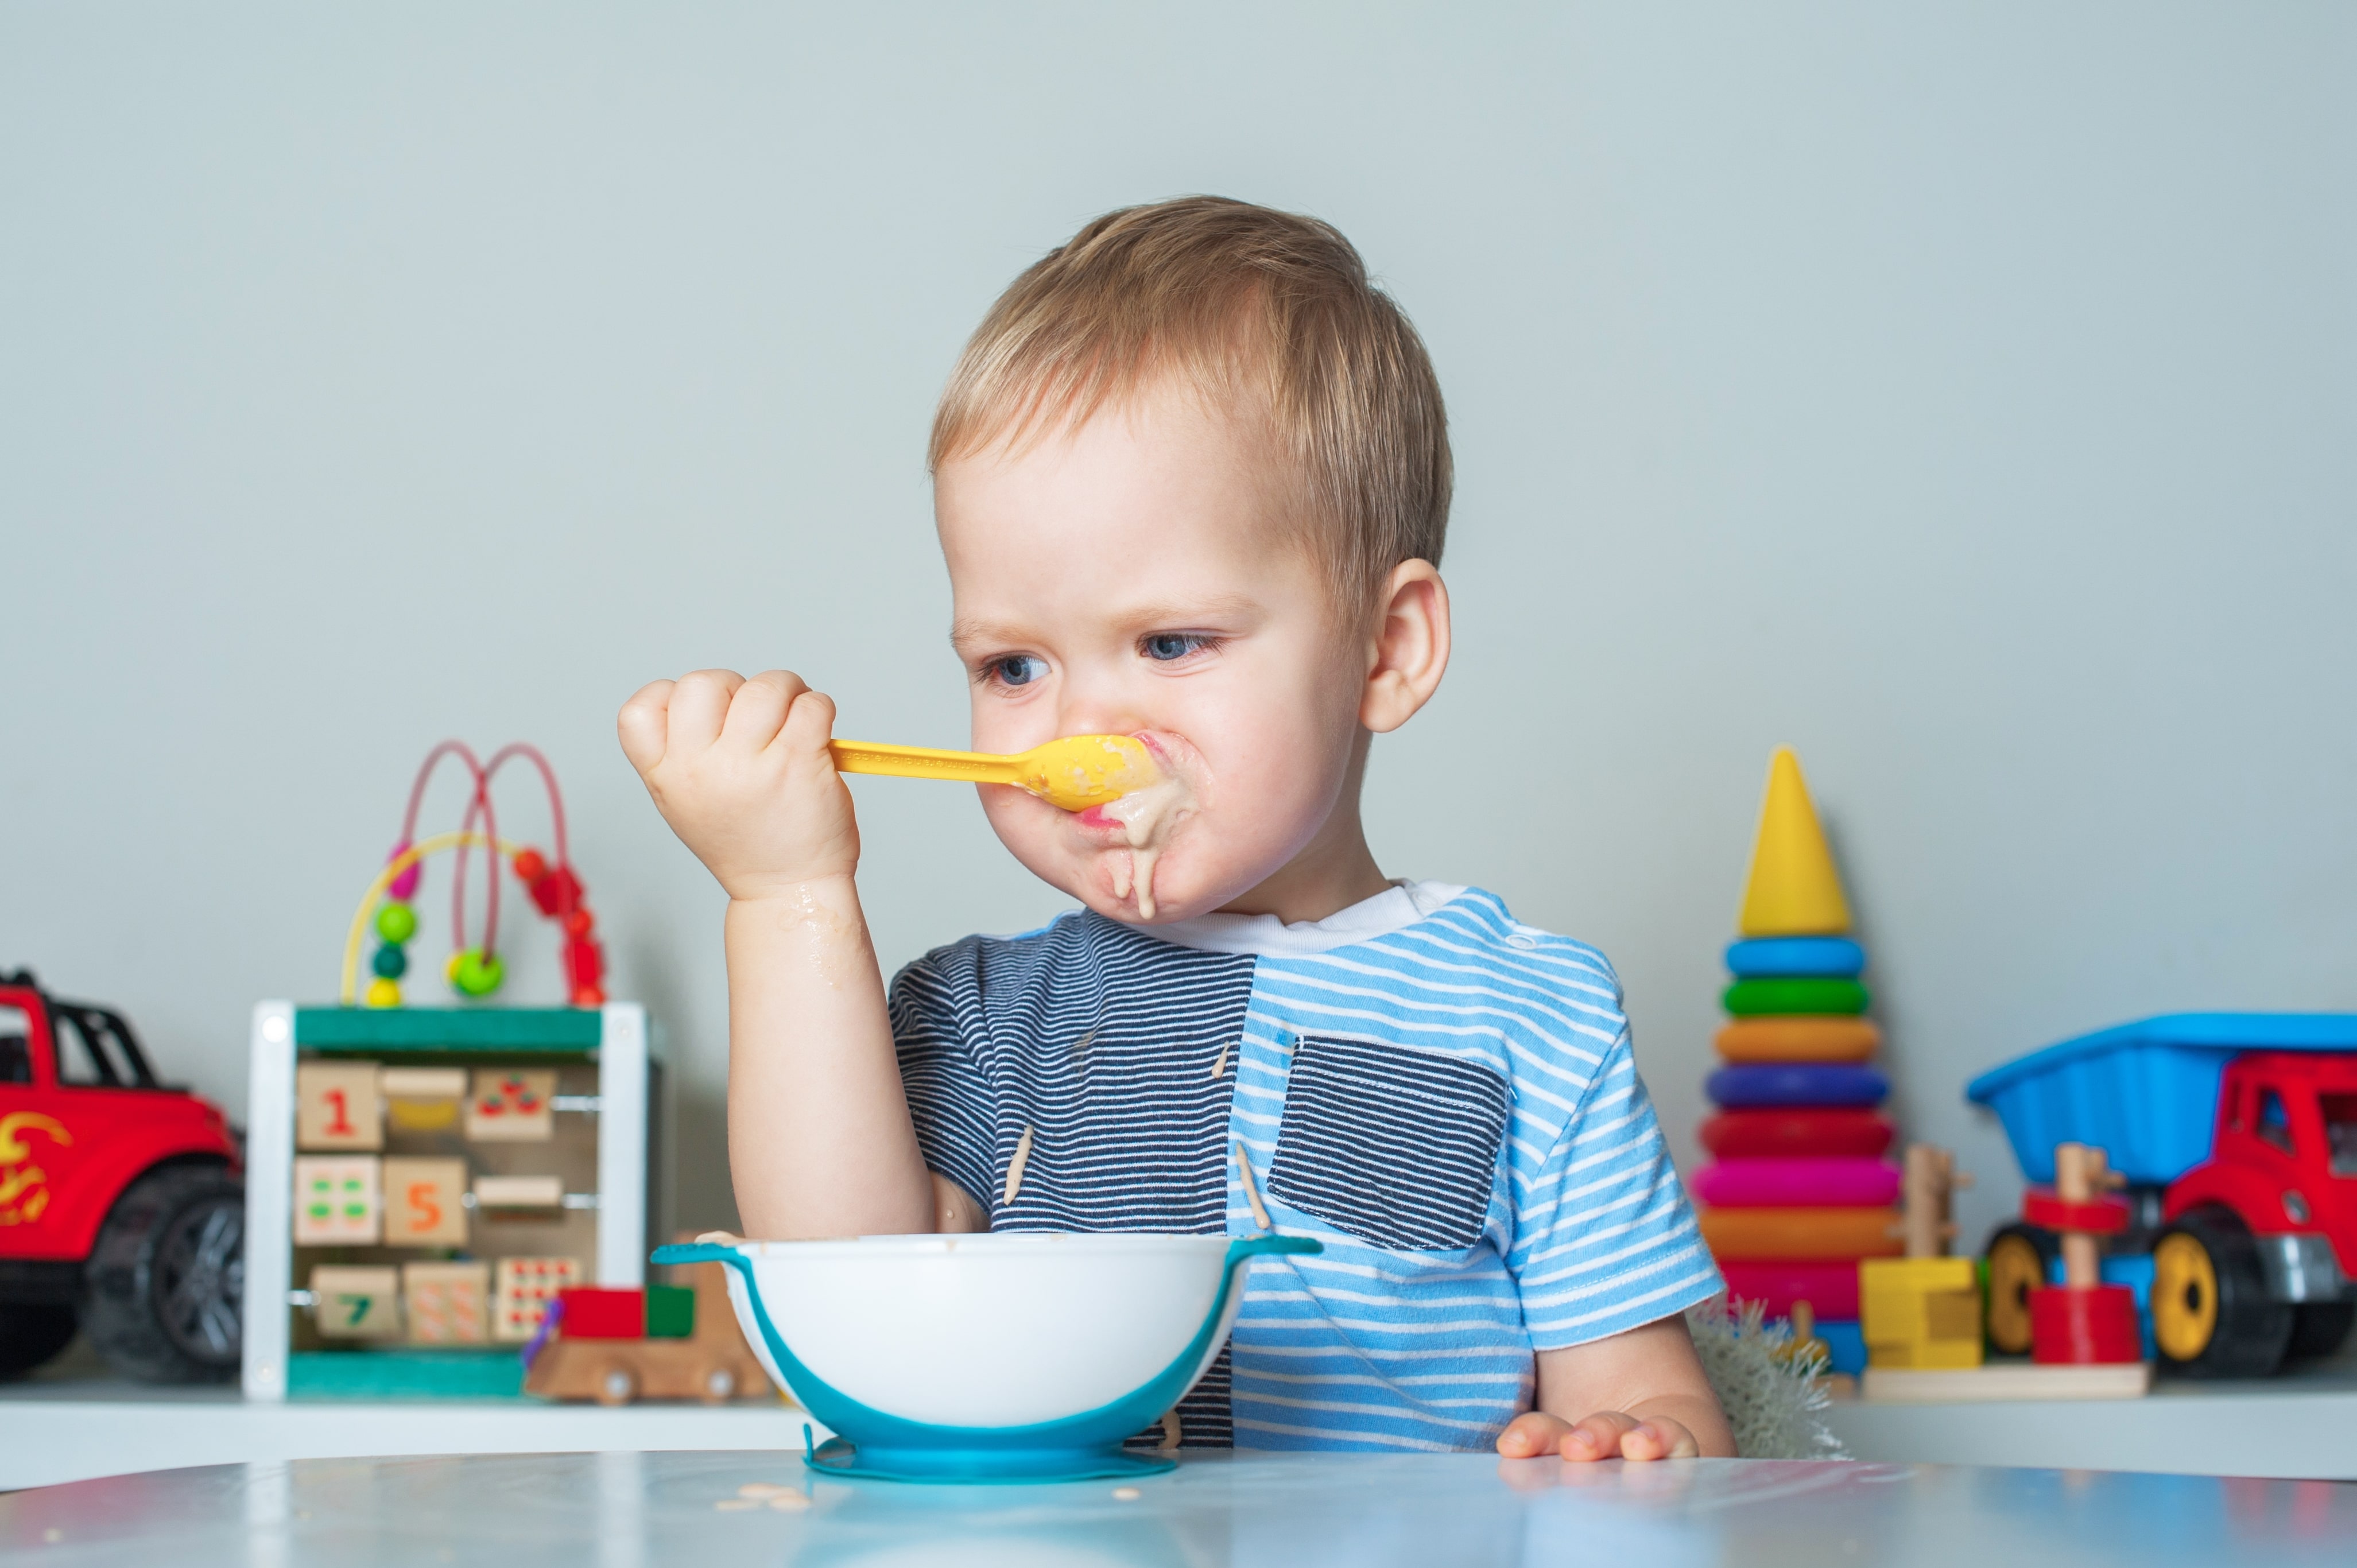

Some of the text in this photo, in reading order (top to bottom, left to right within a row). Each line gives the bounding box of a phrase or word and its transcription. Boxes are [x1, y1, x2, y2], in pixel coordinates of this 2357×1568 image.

[320, 1088, 358, 1137] 1
[406, 1182, 443, 1232] 5
[336, 1294, 372, 1327] 7
